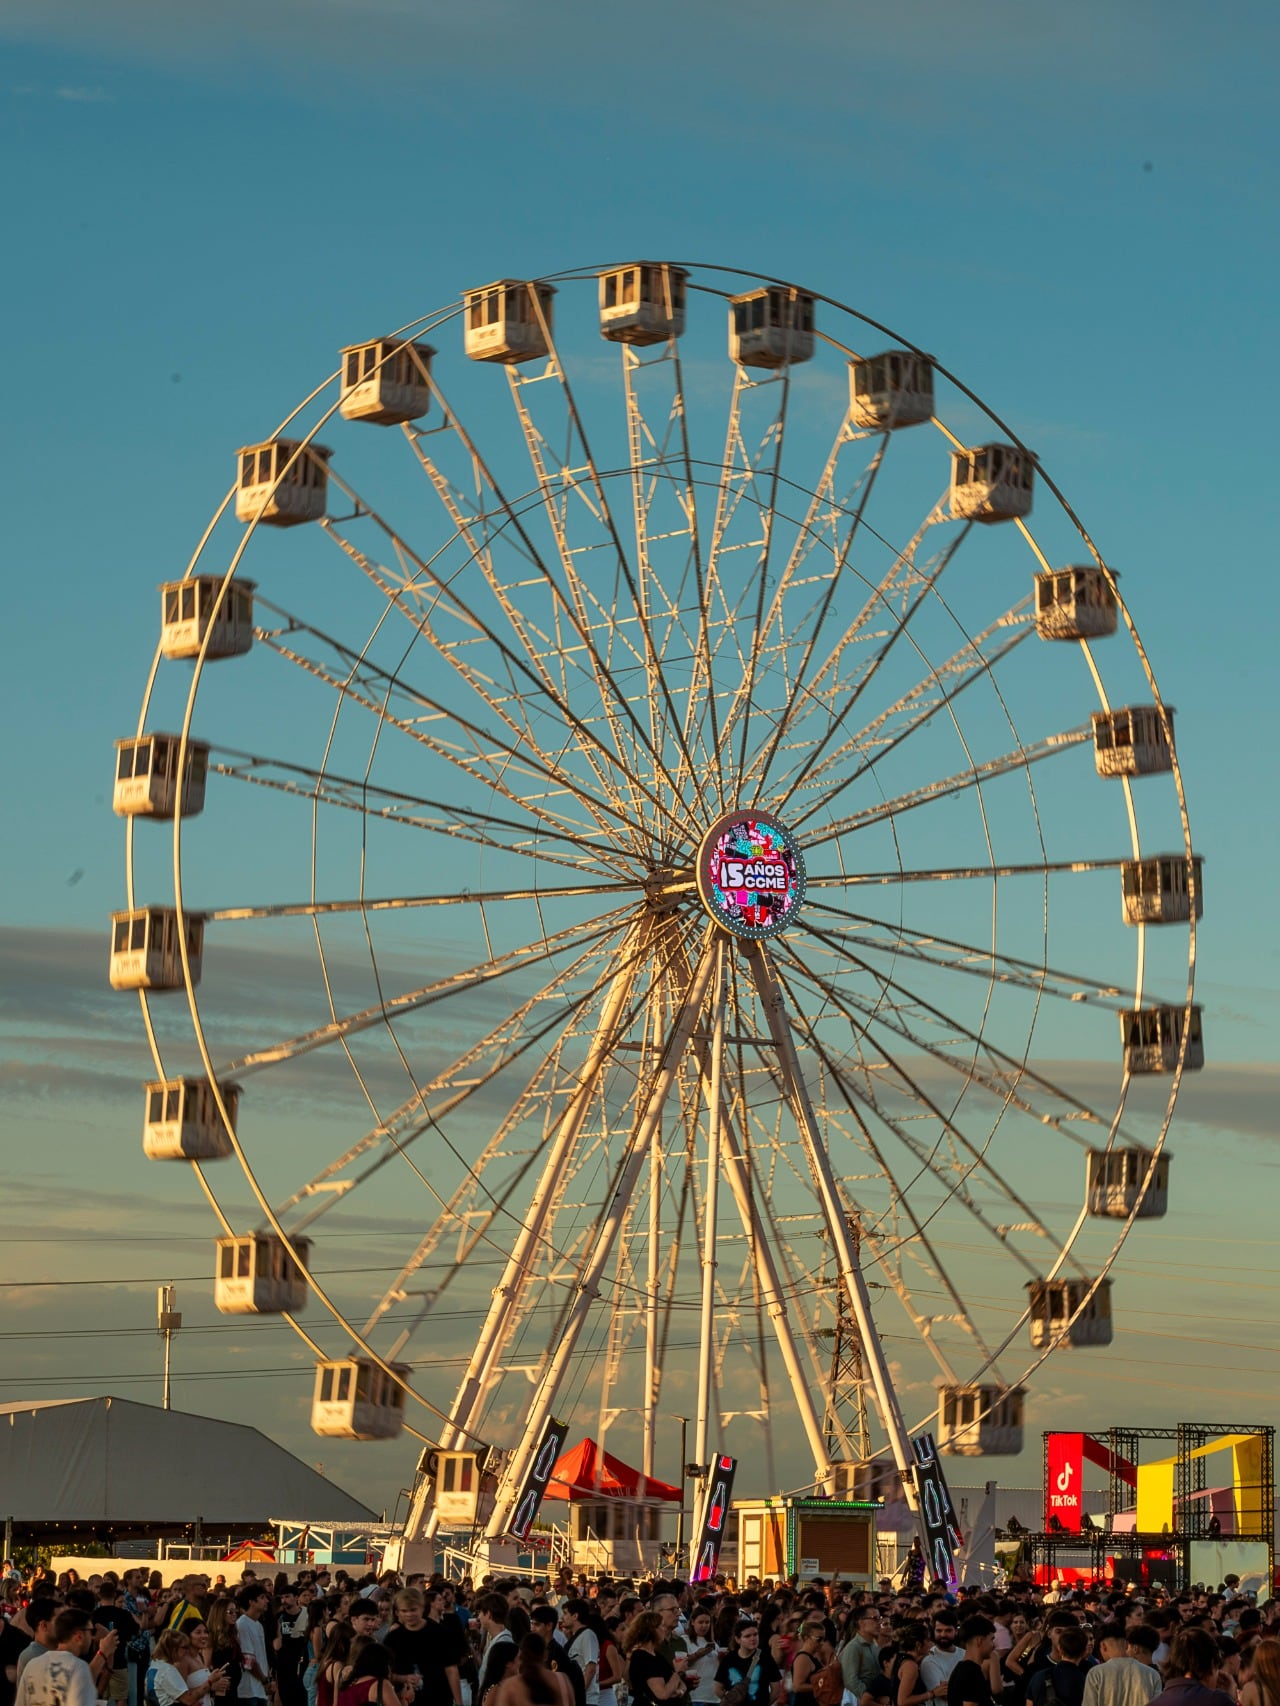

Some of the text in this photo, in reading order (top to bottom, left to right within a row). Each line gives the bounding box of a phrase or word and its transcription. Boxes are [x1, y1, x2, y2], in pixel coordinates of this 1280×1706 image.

[744, 861, 784, 877] AÑOS
[745, 876, 785, 889] CCME
[1050, 1494, 1077, 1507] TikTok
